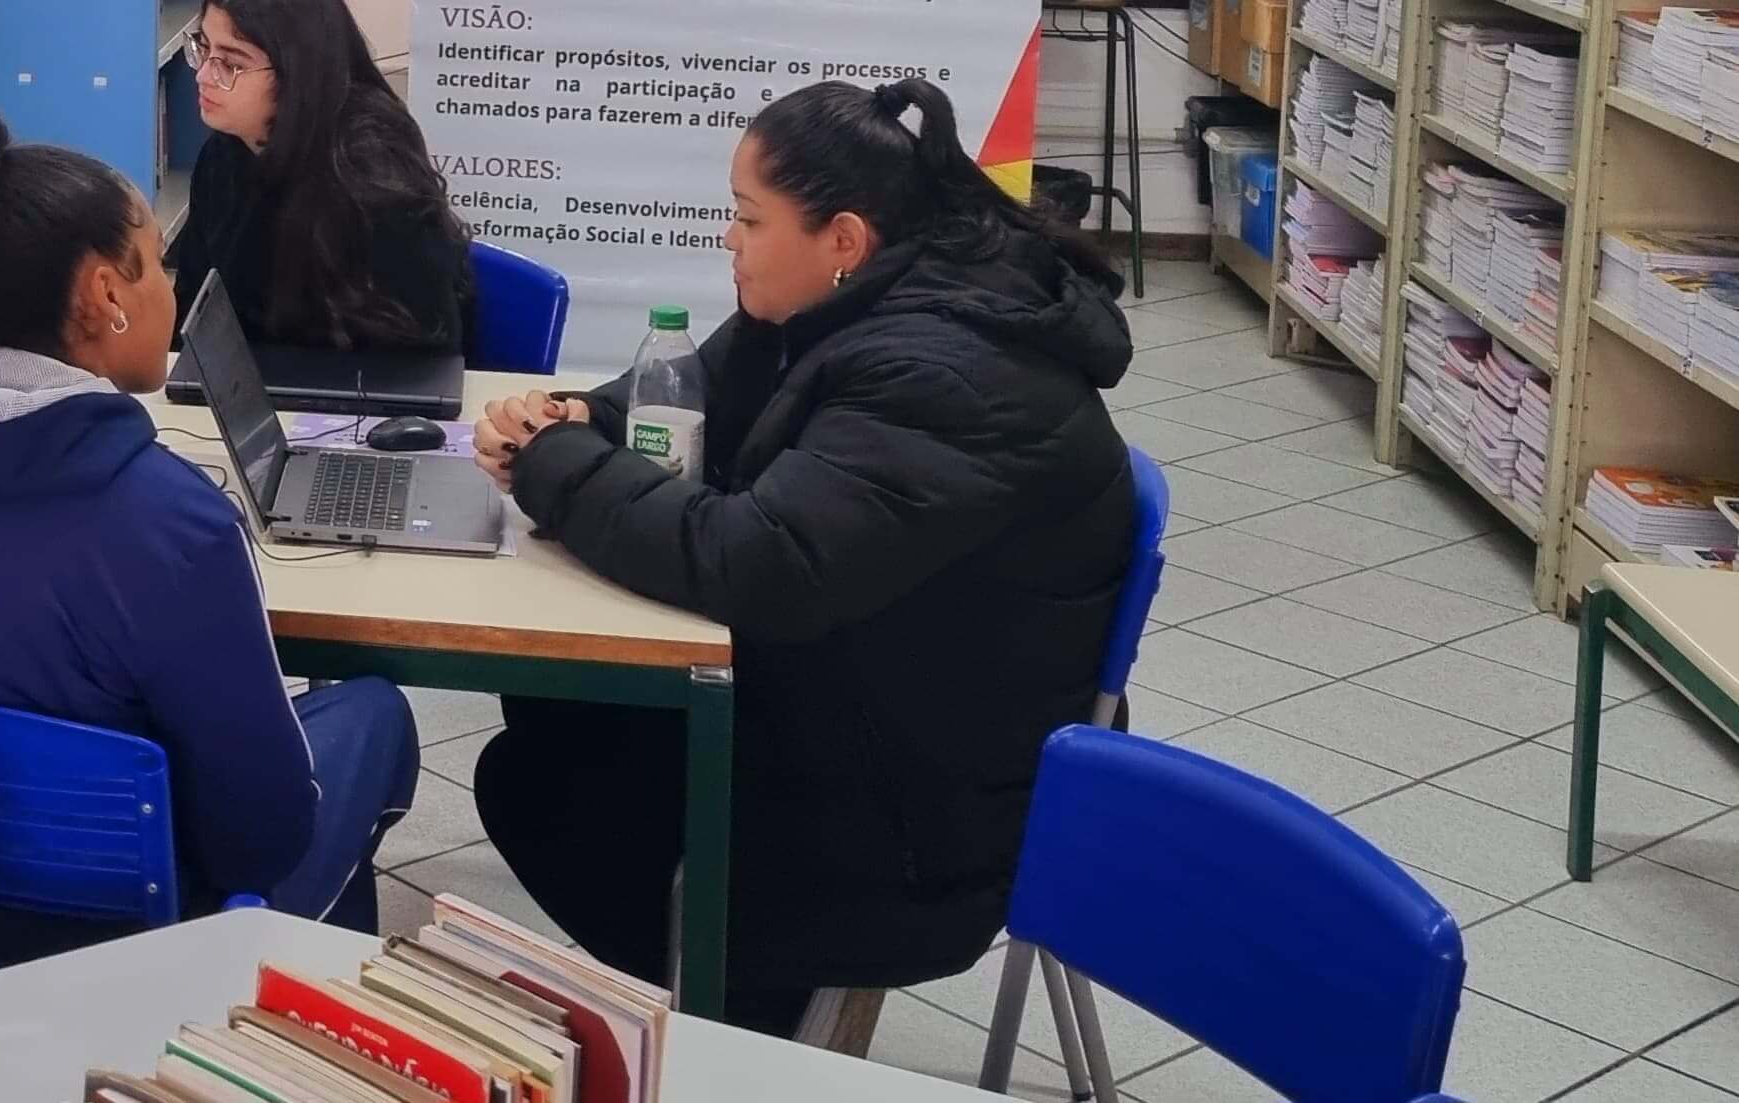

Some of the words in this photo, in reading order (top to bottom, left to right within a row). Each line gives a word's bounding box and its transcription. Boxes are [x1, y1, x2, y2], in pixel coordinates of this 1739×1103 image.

[440, 4, 533, 31] VISÃO:
[438, 42, 545, 63] Identificar
[555, 49, 670, 71] propósitos,
[681, 53, 777, 73] vivenciar
[787, 61, 811, 75] os
[822, 62, 928, 80] processos
[938, 68, 951, 81] e
[436, 71, 531, 90] acreditar
[556, 79, 581, 93] na
[606, 79, 736, 104] participação
[760, 88, 773, 102] e
[435, 97, 540, 119] chamados
[545, 106, 592, 124] para
[598, 104, 682, 126] fazerem
[688, 113, 701, 126] a
[707, 107, 753, 128] difer
[431, 154, 562, 181] VALORES:
[447, 192, 539, 215] celência,
[462, 219, 581, 242] sformação
[585, 225, 645, 245] Social
[651, 232, 663, 246] e
[669, 230, 727, 249] Ident
